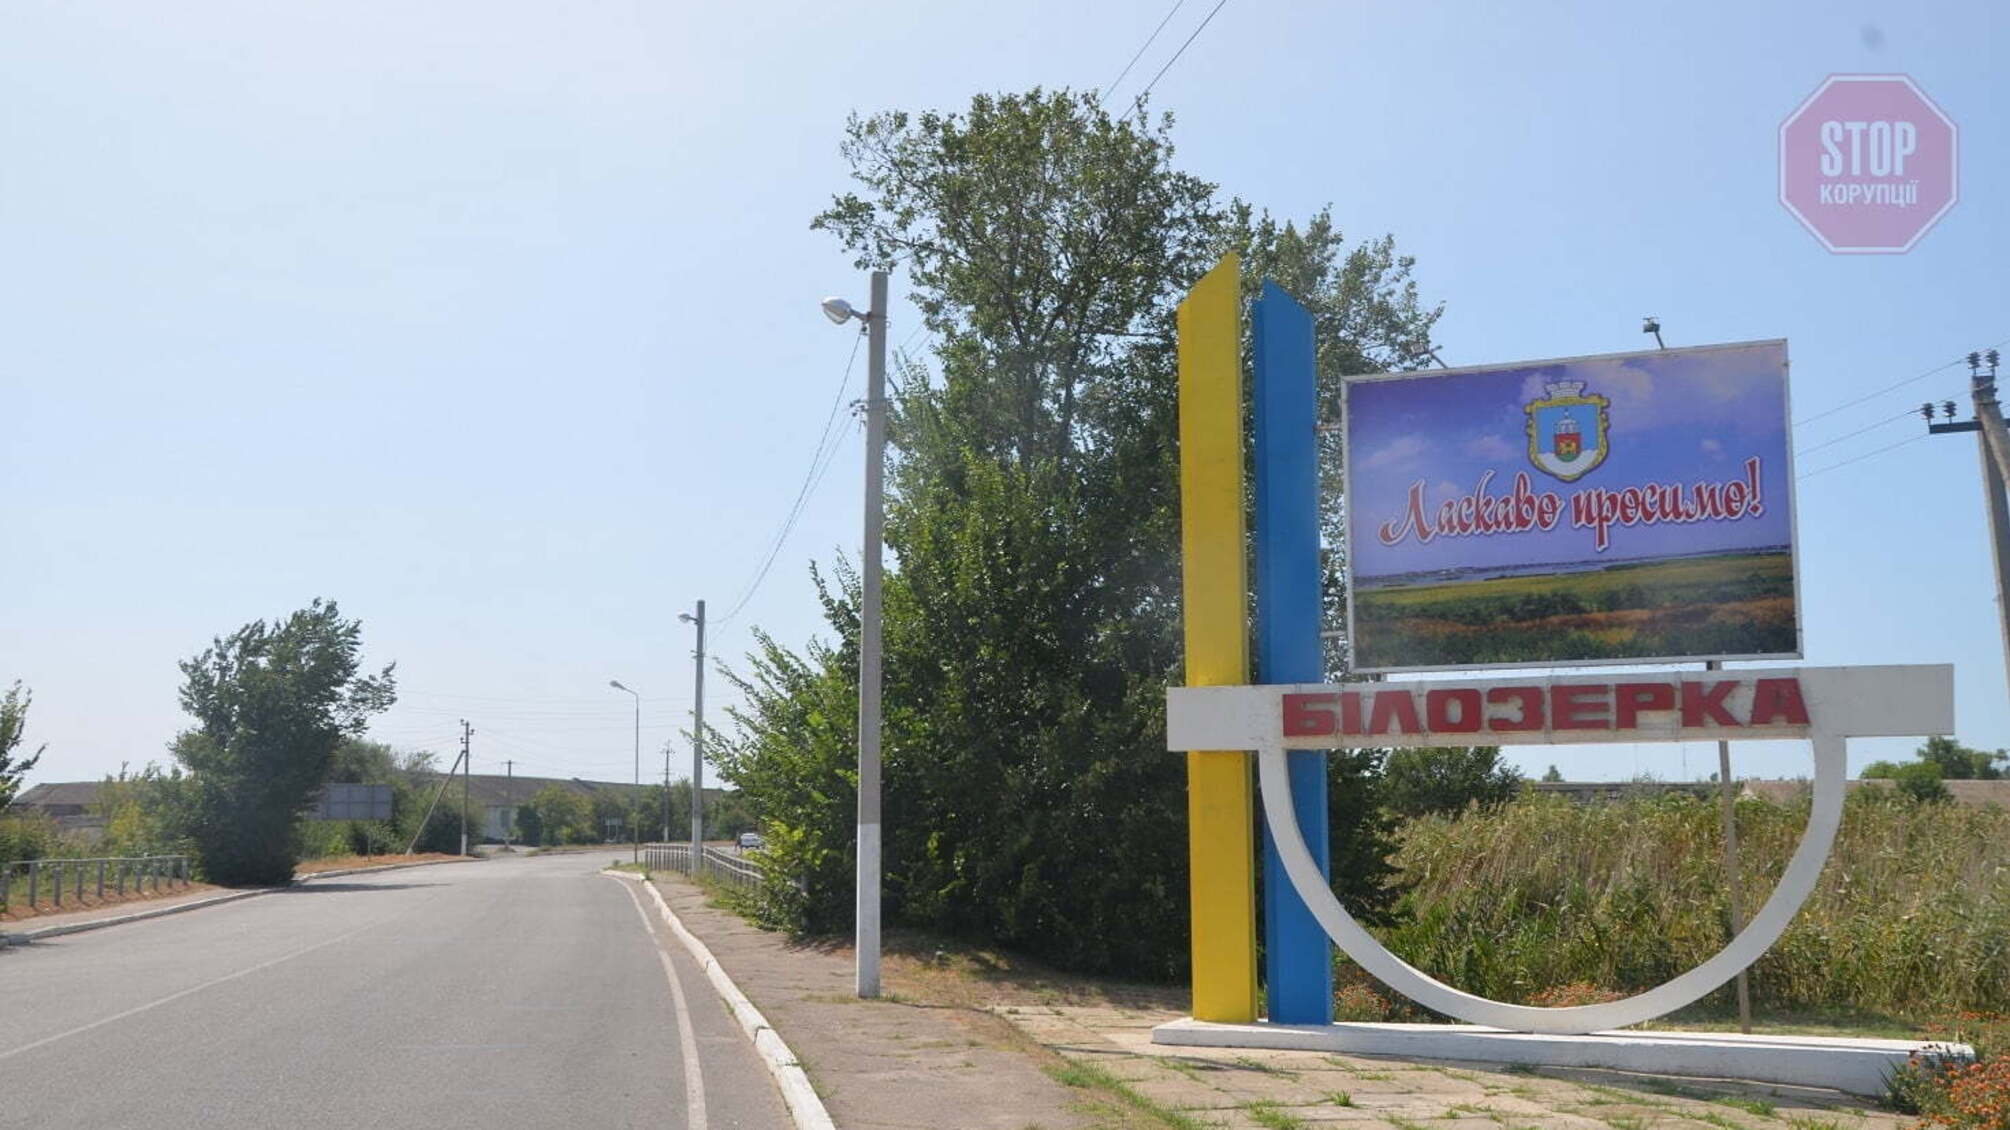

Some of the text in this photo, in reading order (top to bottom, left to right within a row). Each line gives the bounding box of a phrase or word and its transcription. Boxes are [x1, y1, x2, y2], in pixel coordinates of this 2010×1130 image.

[1379, 456, 1765, 552] Ласкаво просимо!
[1283, 677, 1810, 737] БІЛОЗЕРКА
